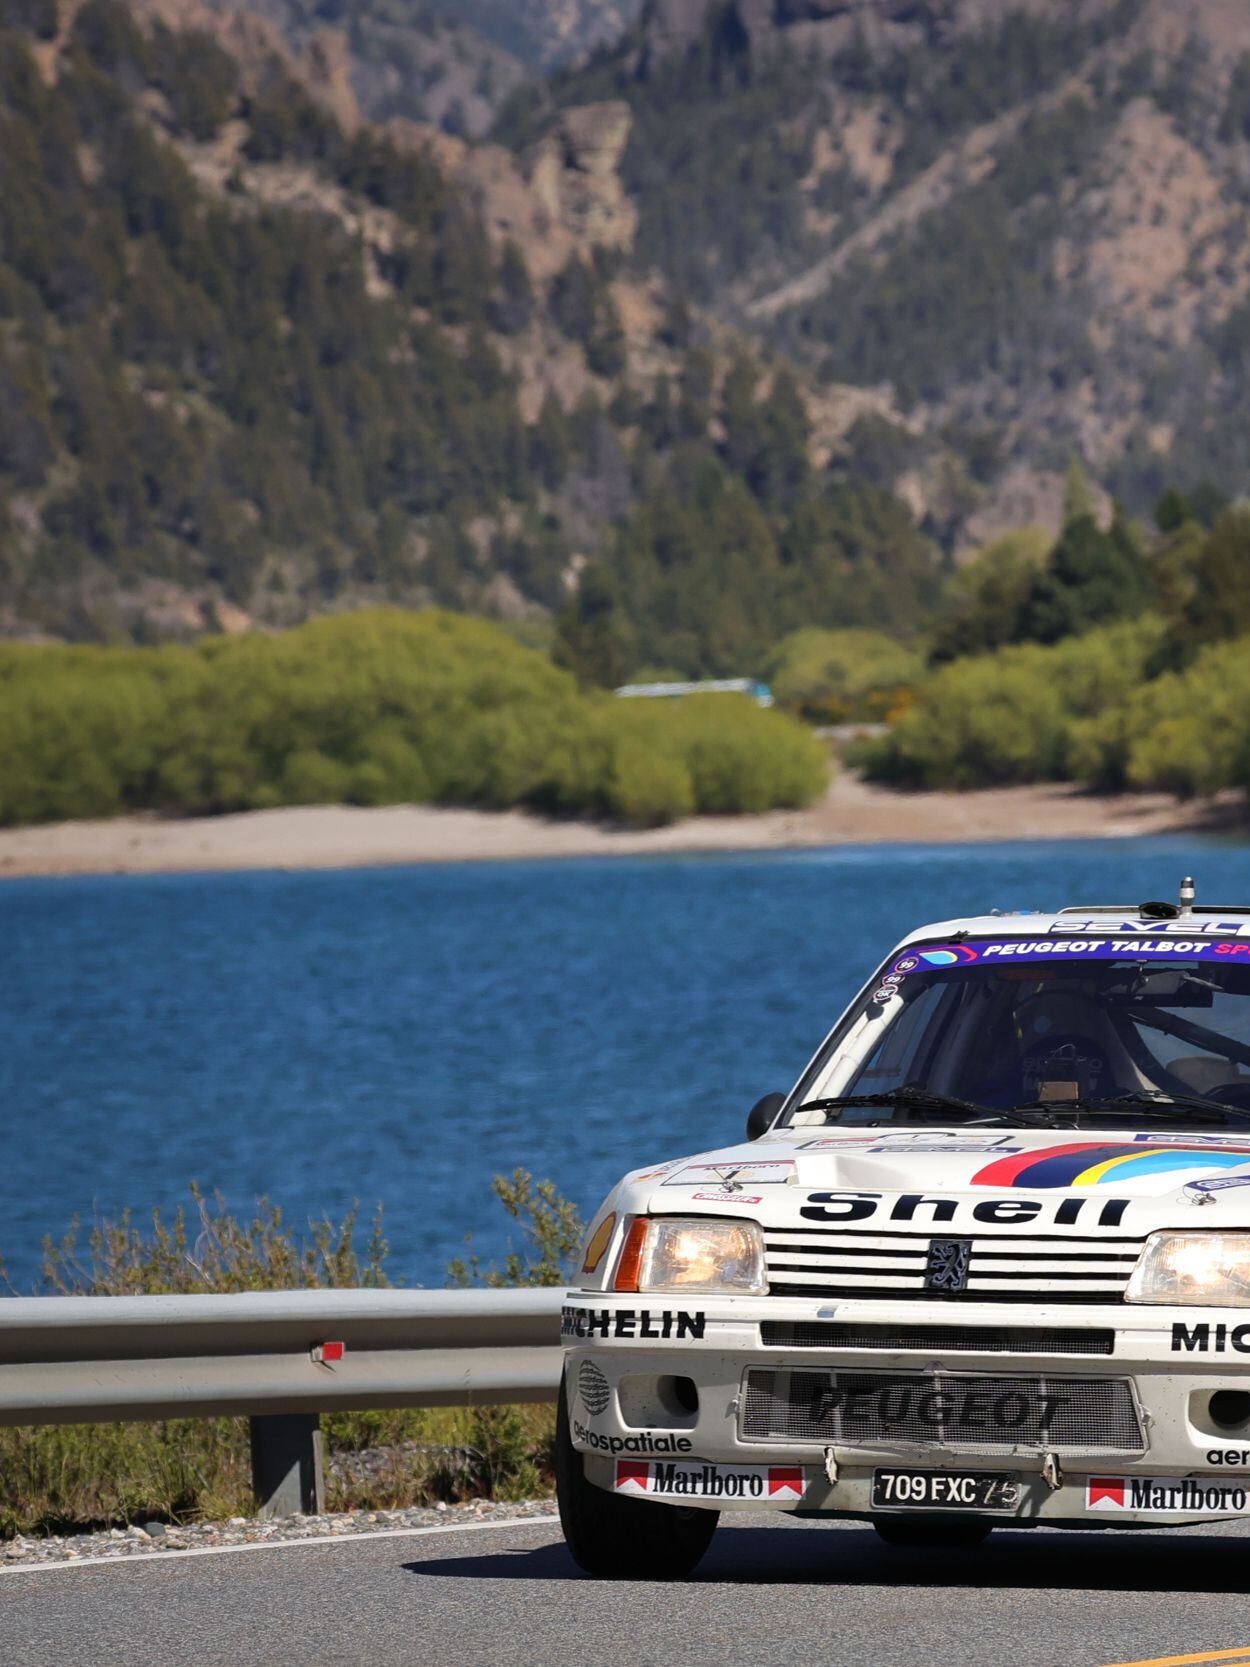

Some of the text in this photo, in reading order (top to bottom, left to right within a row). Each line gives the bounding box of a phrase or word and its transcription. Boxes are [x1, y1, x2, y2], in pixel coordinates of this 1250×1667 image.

[1051, 921, 1238, 935] SEVEL
[982, 941, 1107, 957] PEUGEOT
[1111, 941, 1211, 953] TALBOT
[886, 975, 901, 984] 99
[898, 960, 915, 970] 99
[800, 1192, 1131, 1227] Shell
[808, 1386, 1070, 1429] PEUGEOT
[574, 1420, 693, 1453] aerospatiale
[653, 1462, 763, 1497] Marlboro
[881, 1475, 926, 1500] 709
[931, 1477, 976, 1503] FXC
[1130, 1479, 1247, 1511] Marlboro
